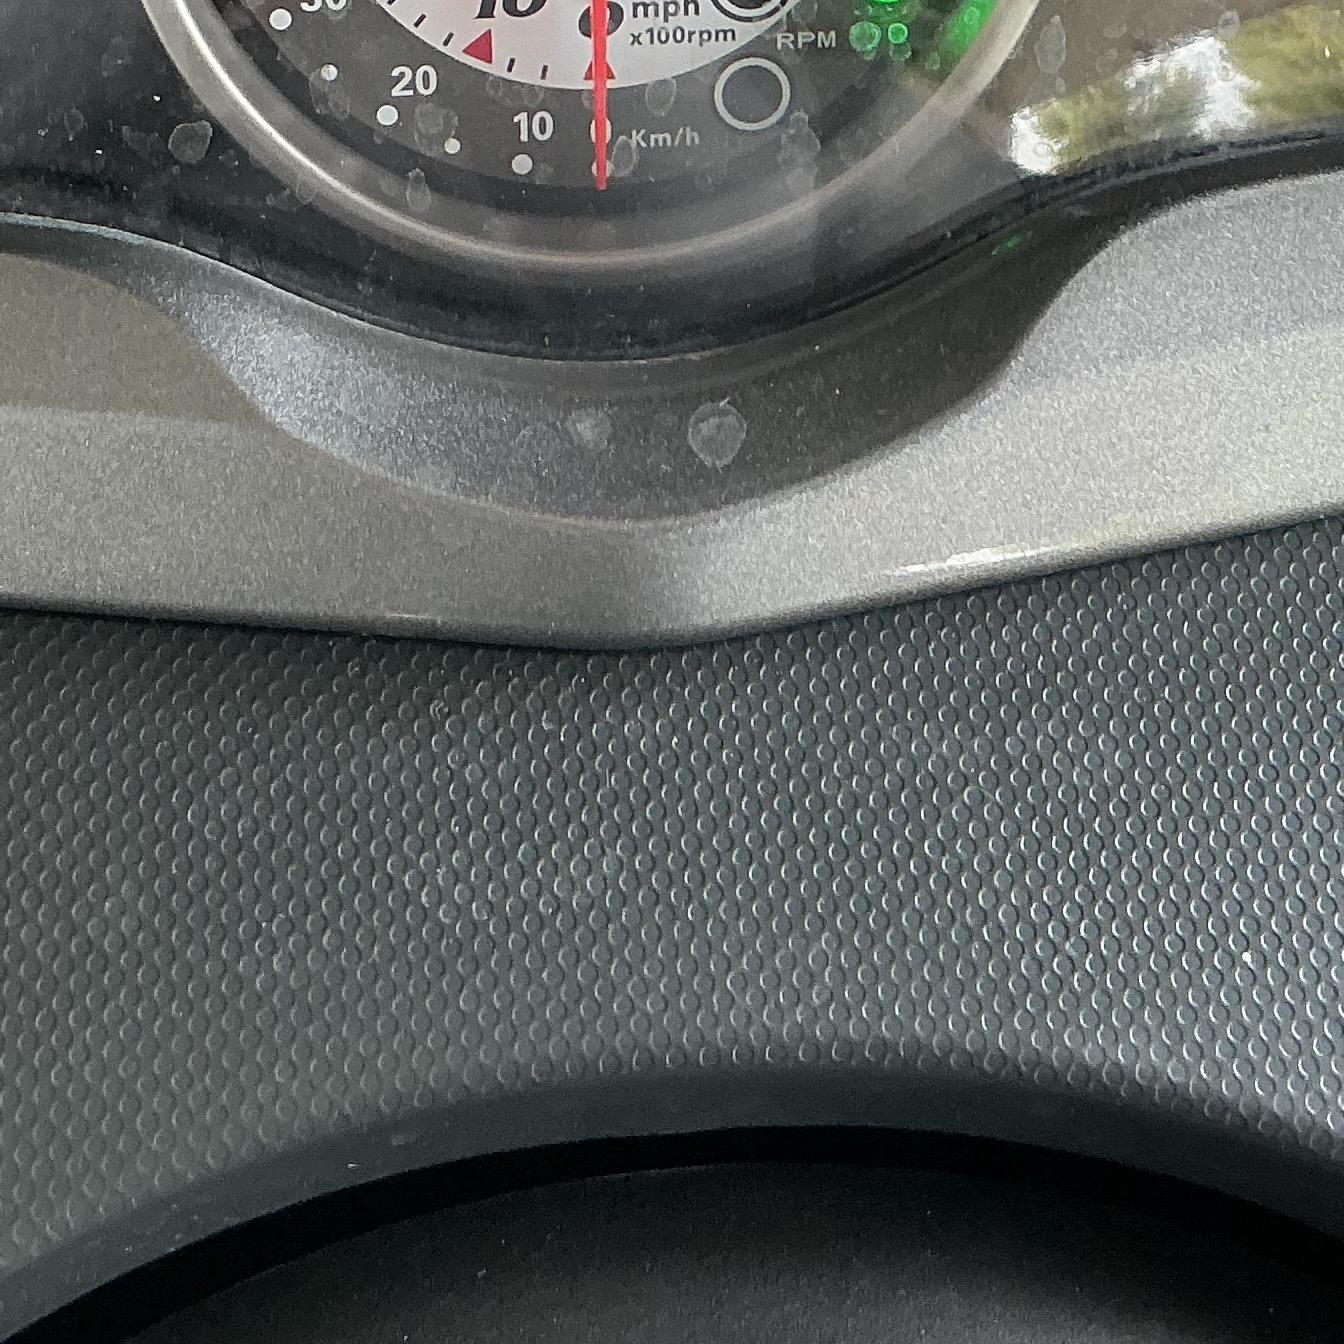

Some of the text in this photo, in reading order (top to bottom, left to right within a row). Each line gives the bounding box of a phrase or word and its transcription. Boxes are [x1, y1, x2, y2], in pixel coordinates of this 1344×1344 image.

[578, 0, 624, 39] 0
[629, 26, 737, 47] x100rpm
[775, 30, 837, 52] RPM
[390, 64, 438, 98] 20
[513, 111, 554, 143] 10
[631, 127, 700, 149] Km/h
